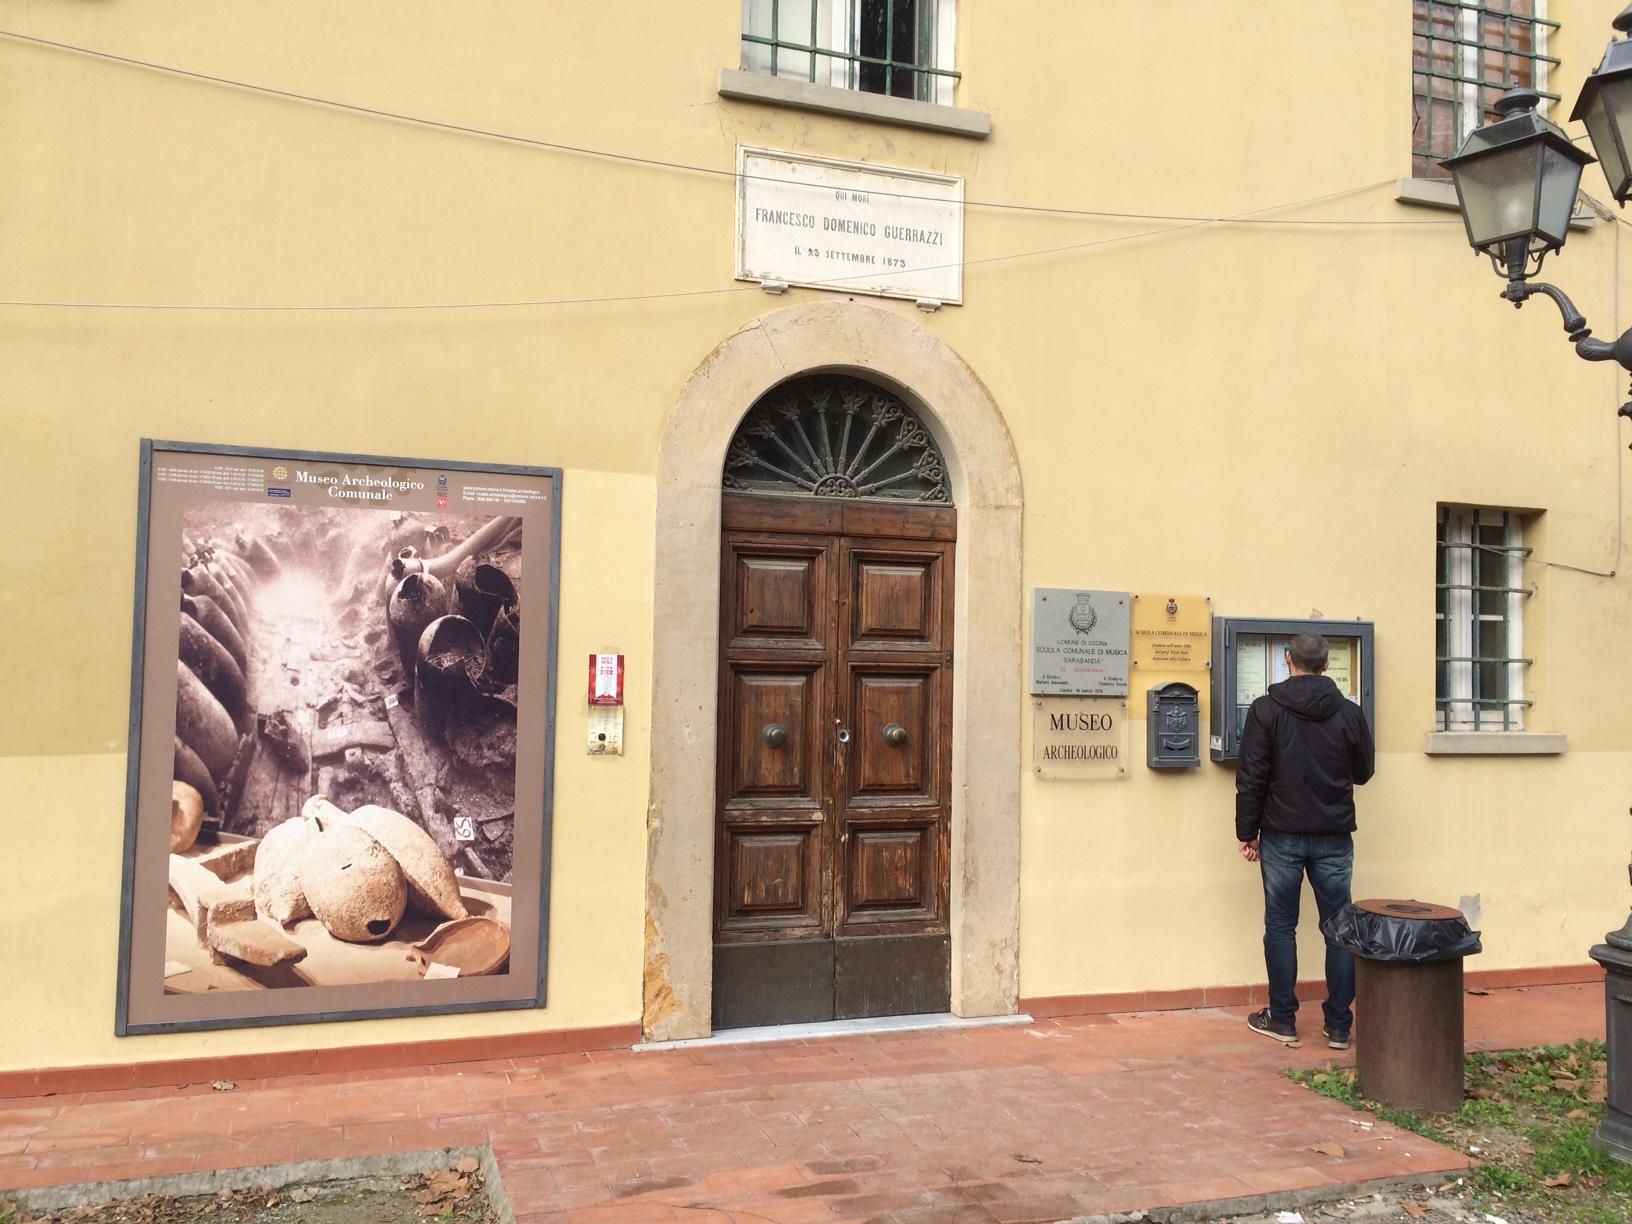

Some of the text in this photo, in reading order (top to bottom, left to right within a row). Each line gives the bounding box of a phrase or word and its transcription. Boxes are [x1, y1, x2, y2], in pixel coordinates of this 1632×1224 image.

[835, 190, 848, 201] QUI
[755, 207, 944, 247] FRANCESCO DOMENICO GUERRAZZI
[794, 245, 802, 255] IL
[825, 250, 876, 265] SETTEMBRE
[882, 256, 906, 268] 1873
[295, 470, 425, 491] Museo Archeologico
[328, 486, 393, 501] Comunale
[1036, 646, 1061, 654] SCUOLA
[1062, 647, 1096, 655] COMUNALE
[1050, 713, 1113, 731] MUSEO
[1043, 744, 1118, 760] ARCHEOLOGICO
